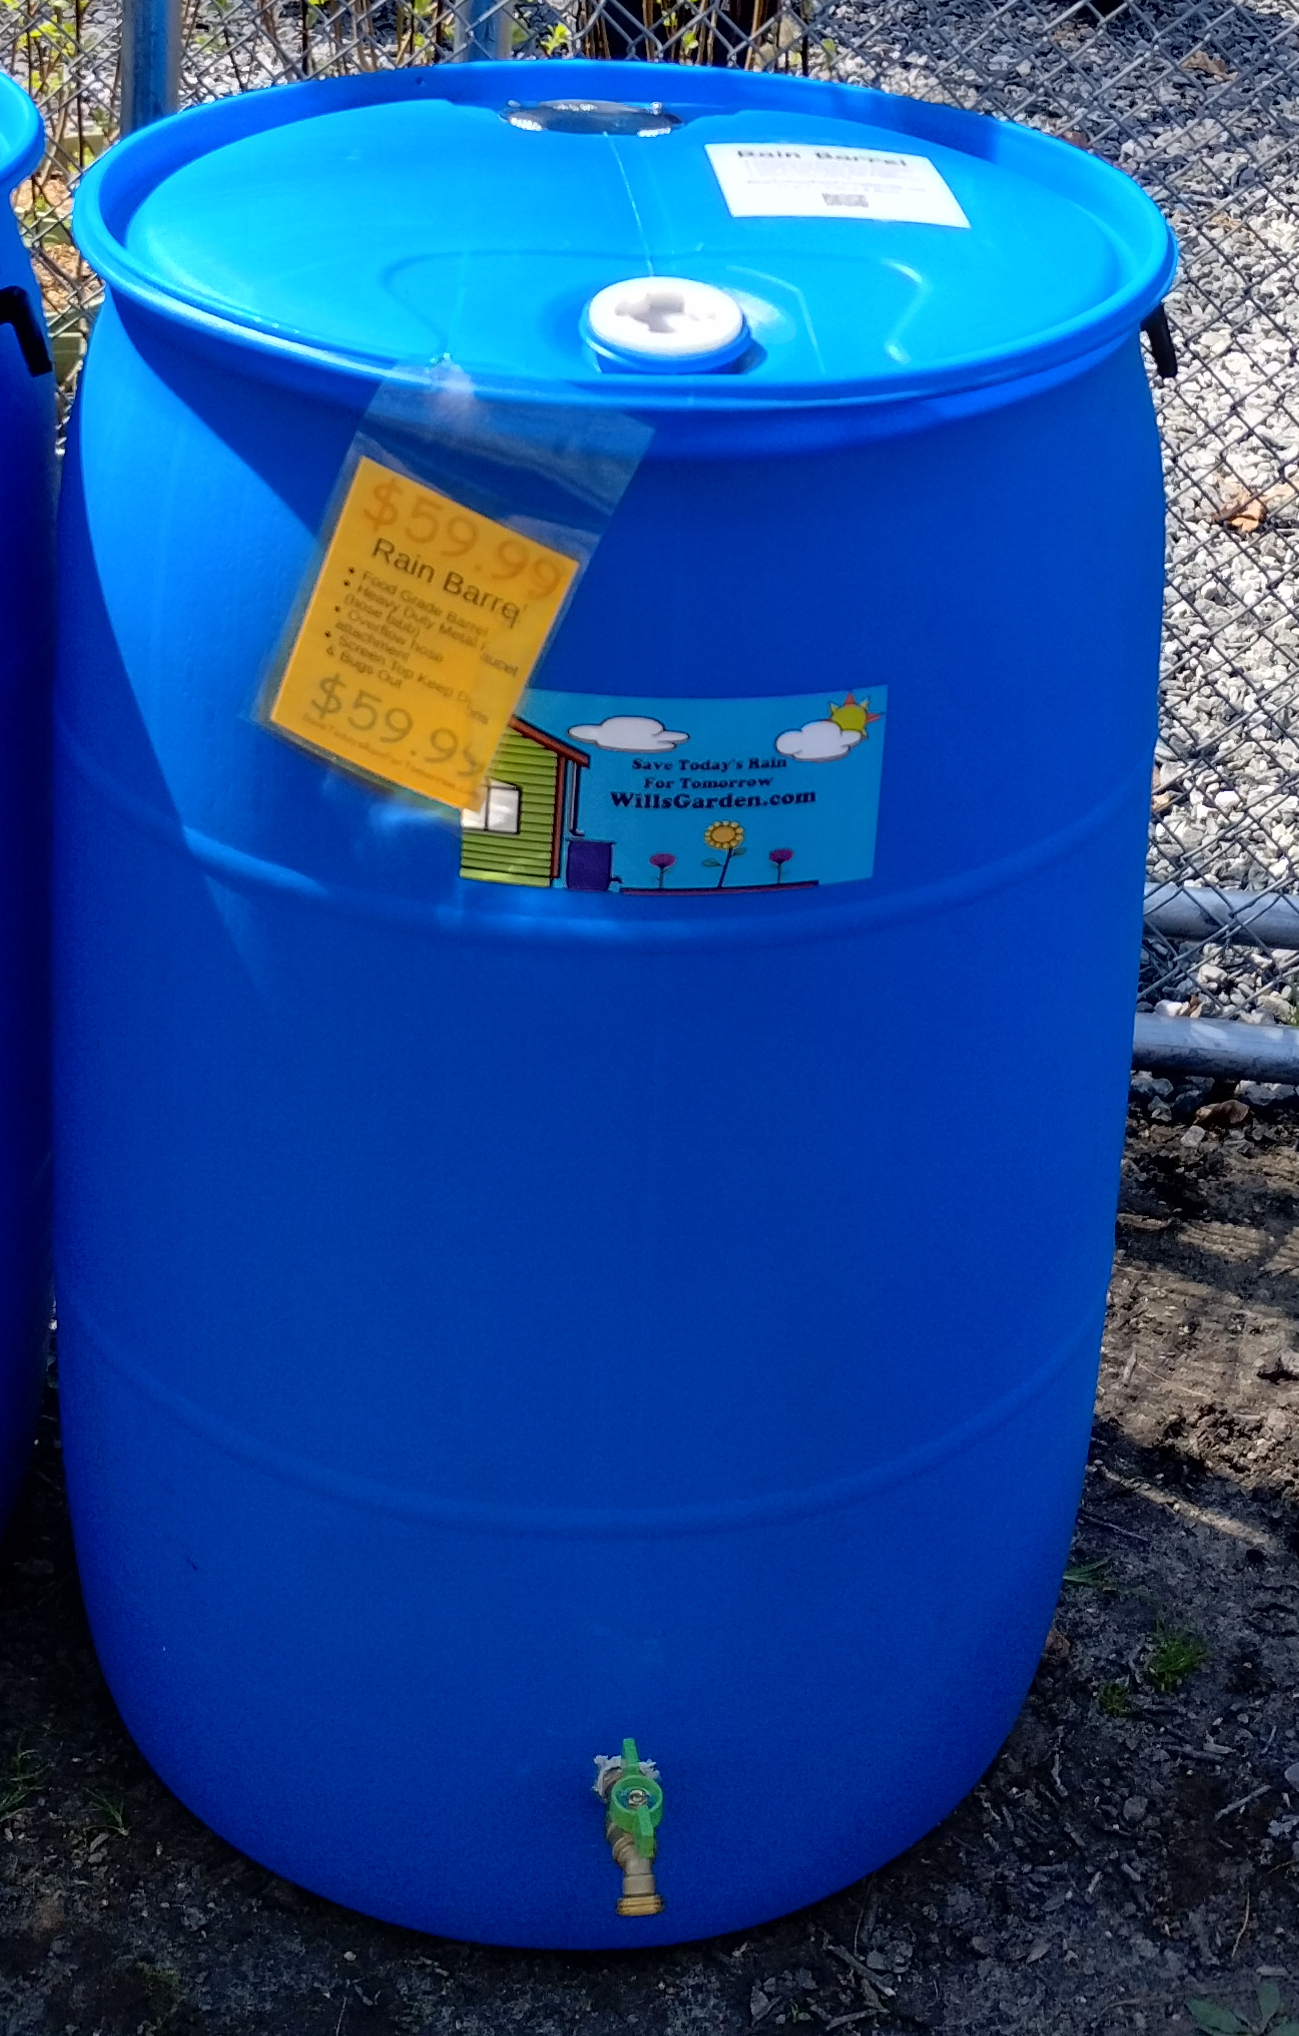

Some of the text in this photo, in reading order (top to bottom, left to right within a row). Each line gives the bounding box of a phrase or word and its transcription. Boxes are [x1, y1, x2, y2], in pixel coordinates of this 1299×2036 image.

[363, 478, 562, 598] $59.99
[372, 537, 436, 584] Rain
[344, 593, 382, 618] (hose
[357, 585, 400, 613] Heavy
[403, 606, 435, 630] Duty
[439, 622, 480, 648] Metal
[362, 570, 490, 636] Food Grade Barrel
[335, 620, 411, 663] attachment
[348, 610, 444, 663] Overflow hose
[339, 635, 386, 666] Screen
[391, 659, 415, 680] Top
[417, 672, 454, 698] Keep
[340, 650, 375, 676] Bugs
[378, 669, 404, 690] Out
[632, 756, 788, 773] Save Today's Rain
[643, 776, 774, 789] For Tomorrow
[610, 791, 817, 809] WillsGarden.com
